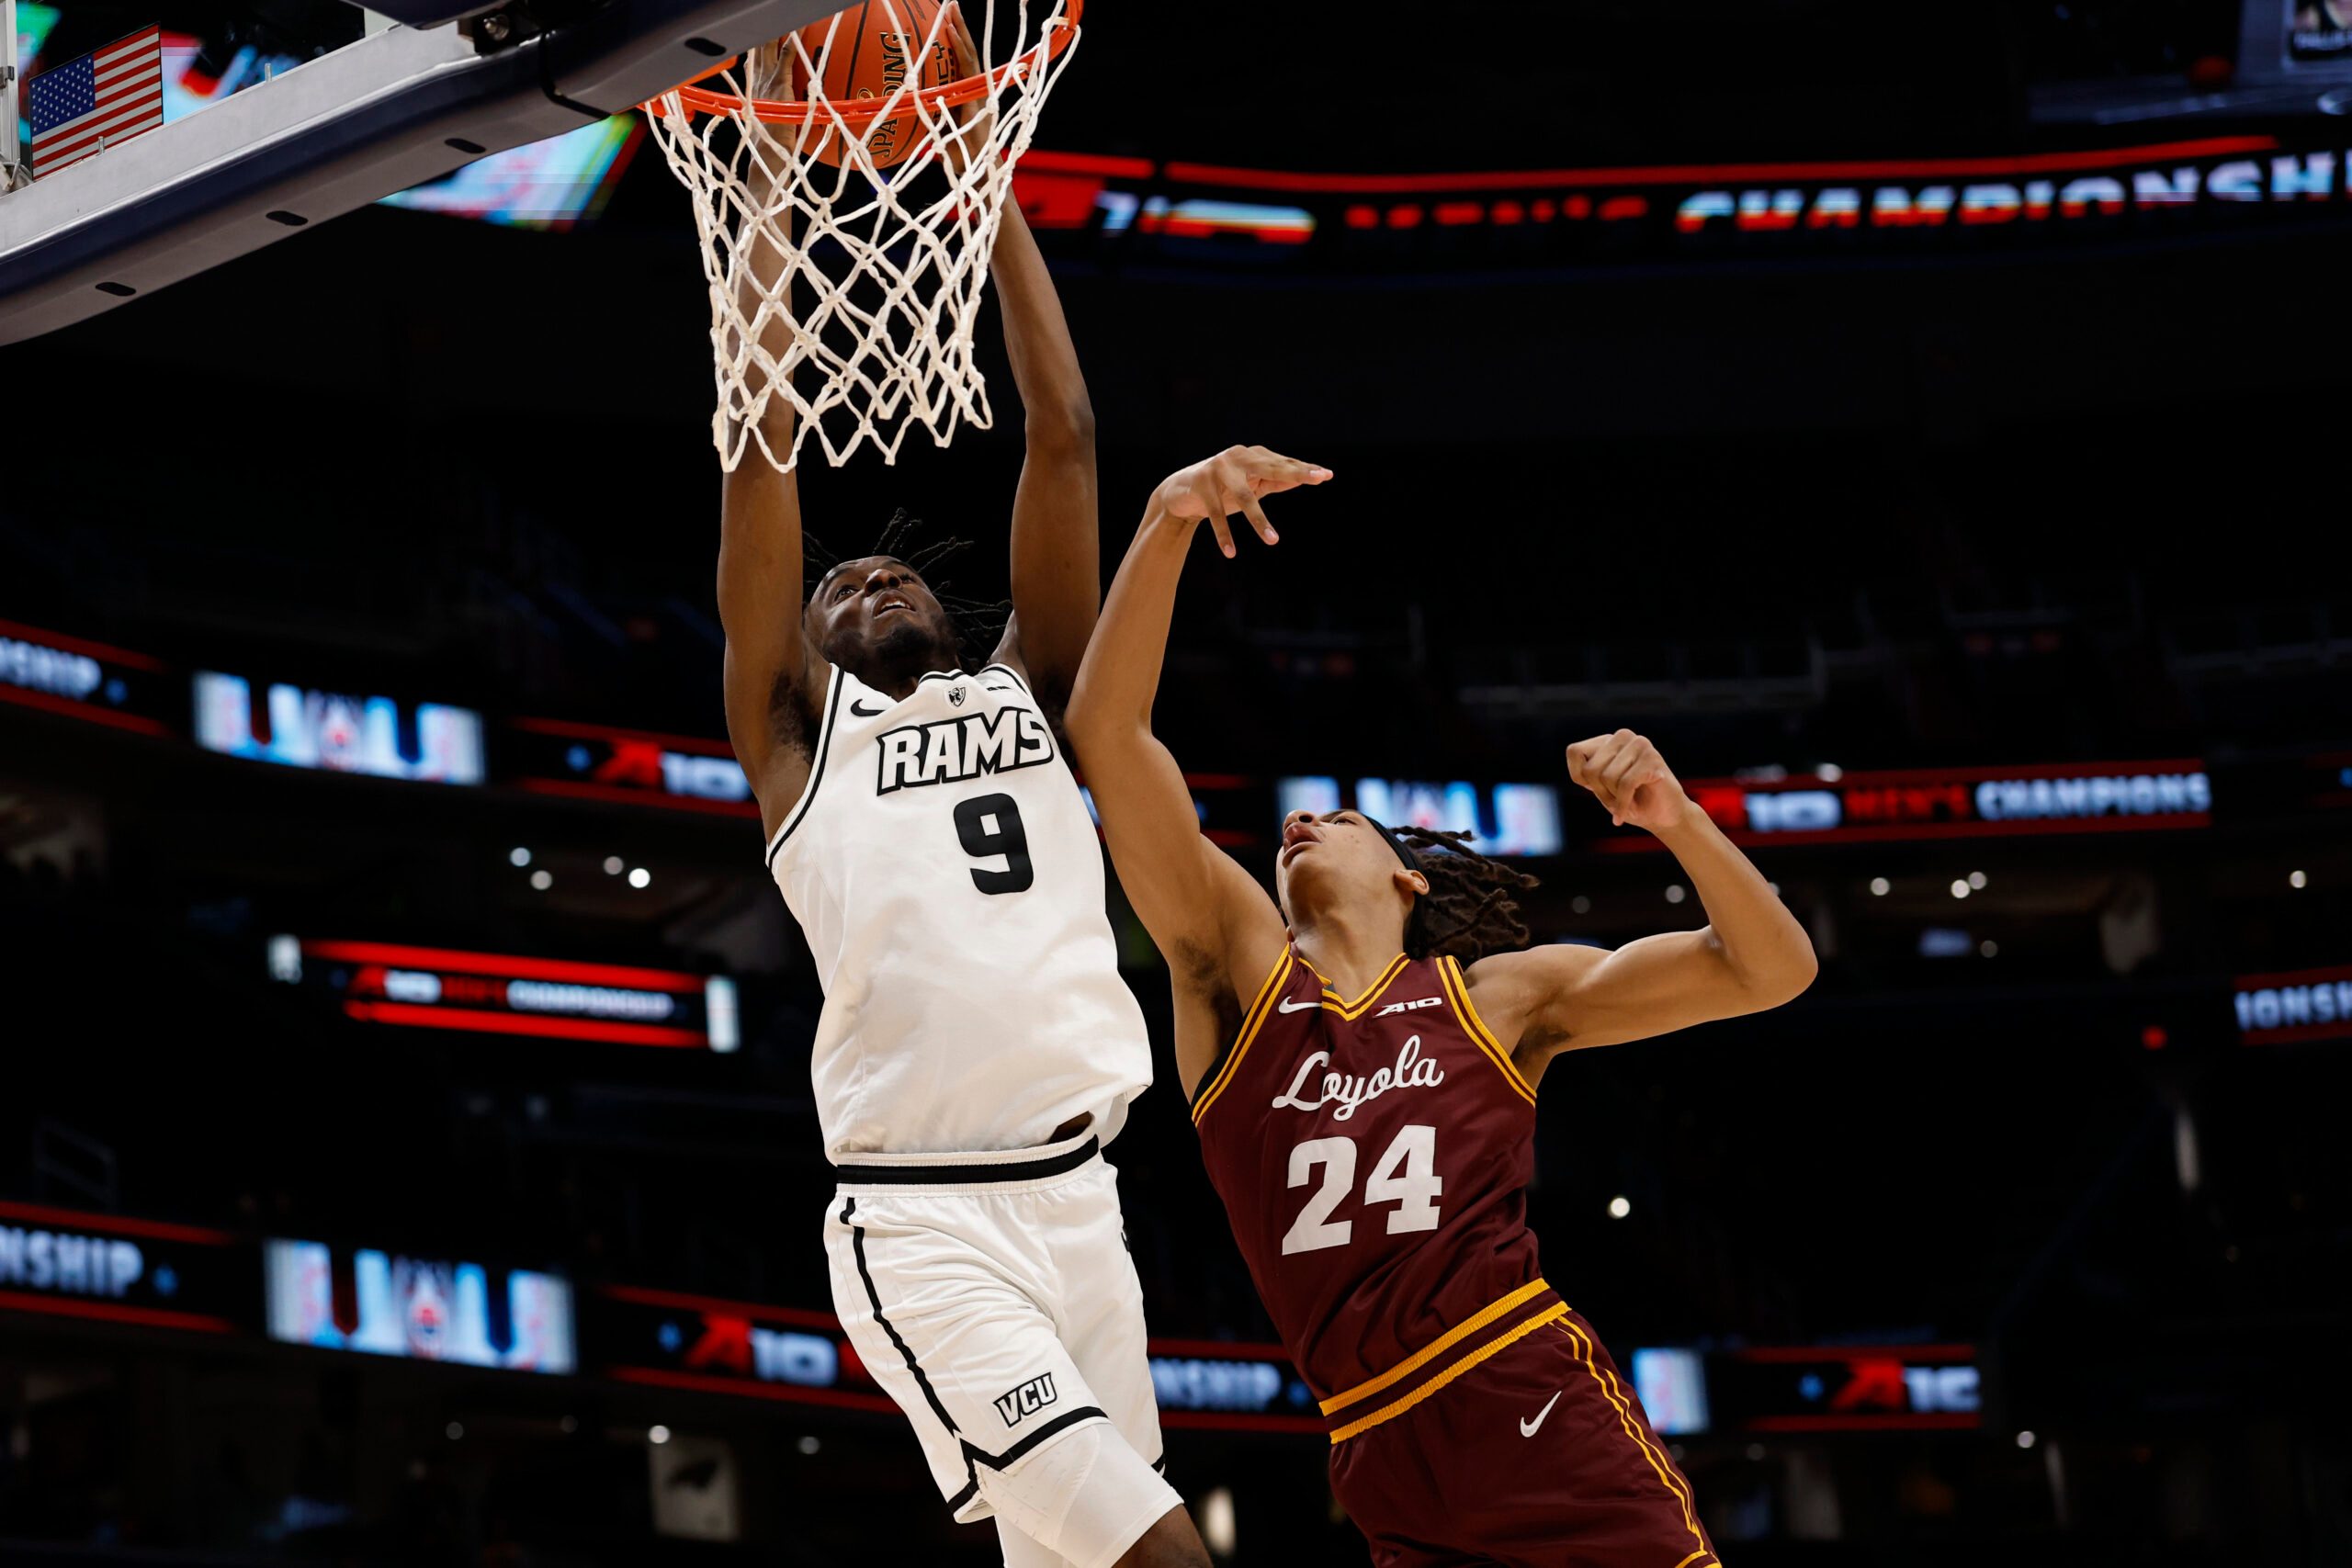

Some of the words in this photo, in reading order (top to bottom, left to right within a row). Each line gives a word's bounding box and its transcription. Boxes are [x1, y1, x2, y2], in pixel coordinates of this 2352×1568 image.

[864, 31, 910, 158] SPADING
[876, 706, 1054, 795] RAMS
[954, 793, 1034, 895] 9
[1374, 997, 1442, 1018] A10
[1272, 1034, 1444, 1122] Loyola
[1282, 1124, 1442, 1256] 24
[993, 1371, 1057, 1428] VCU
